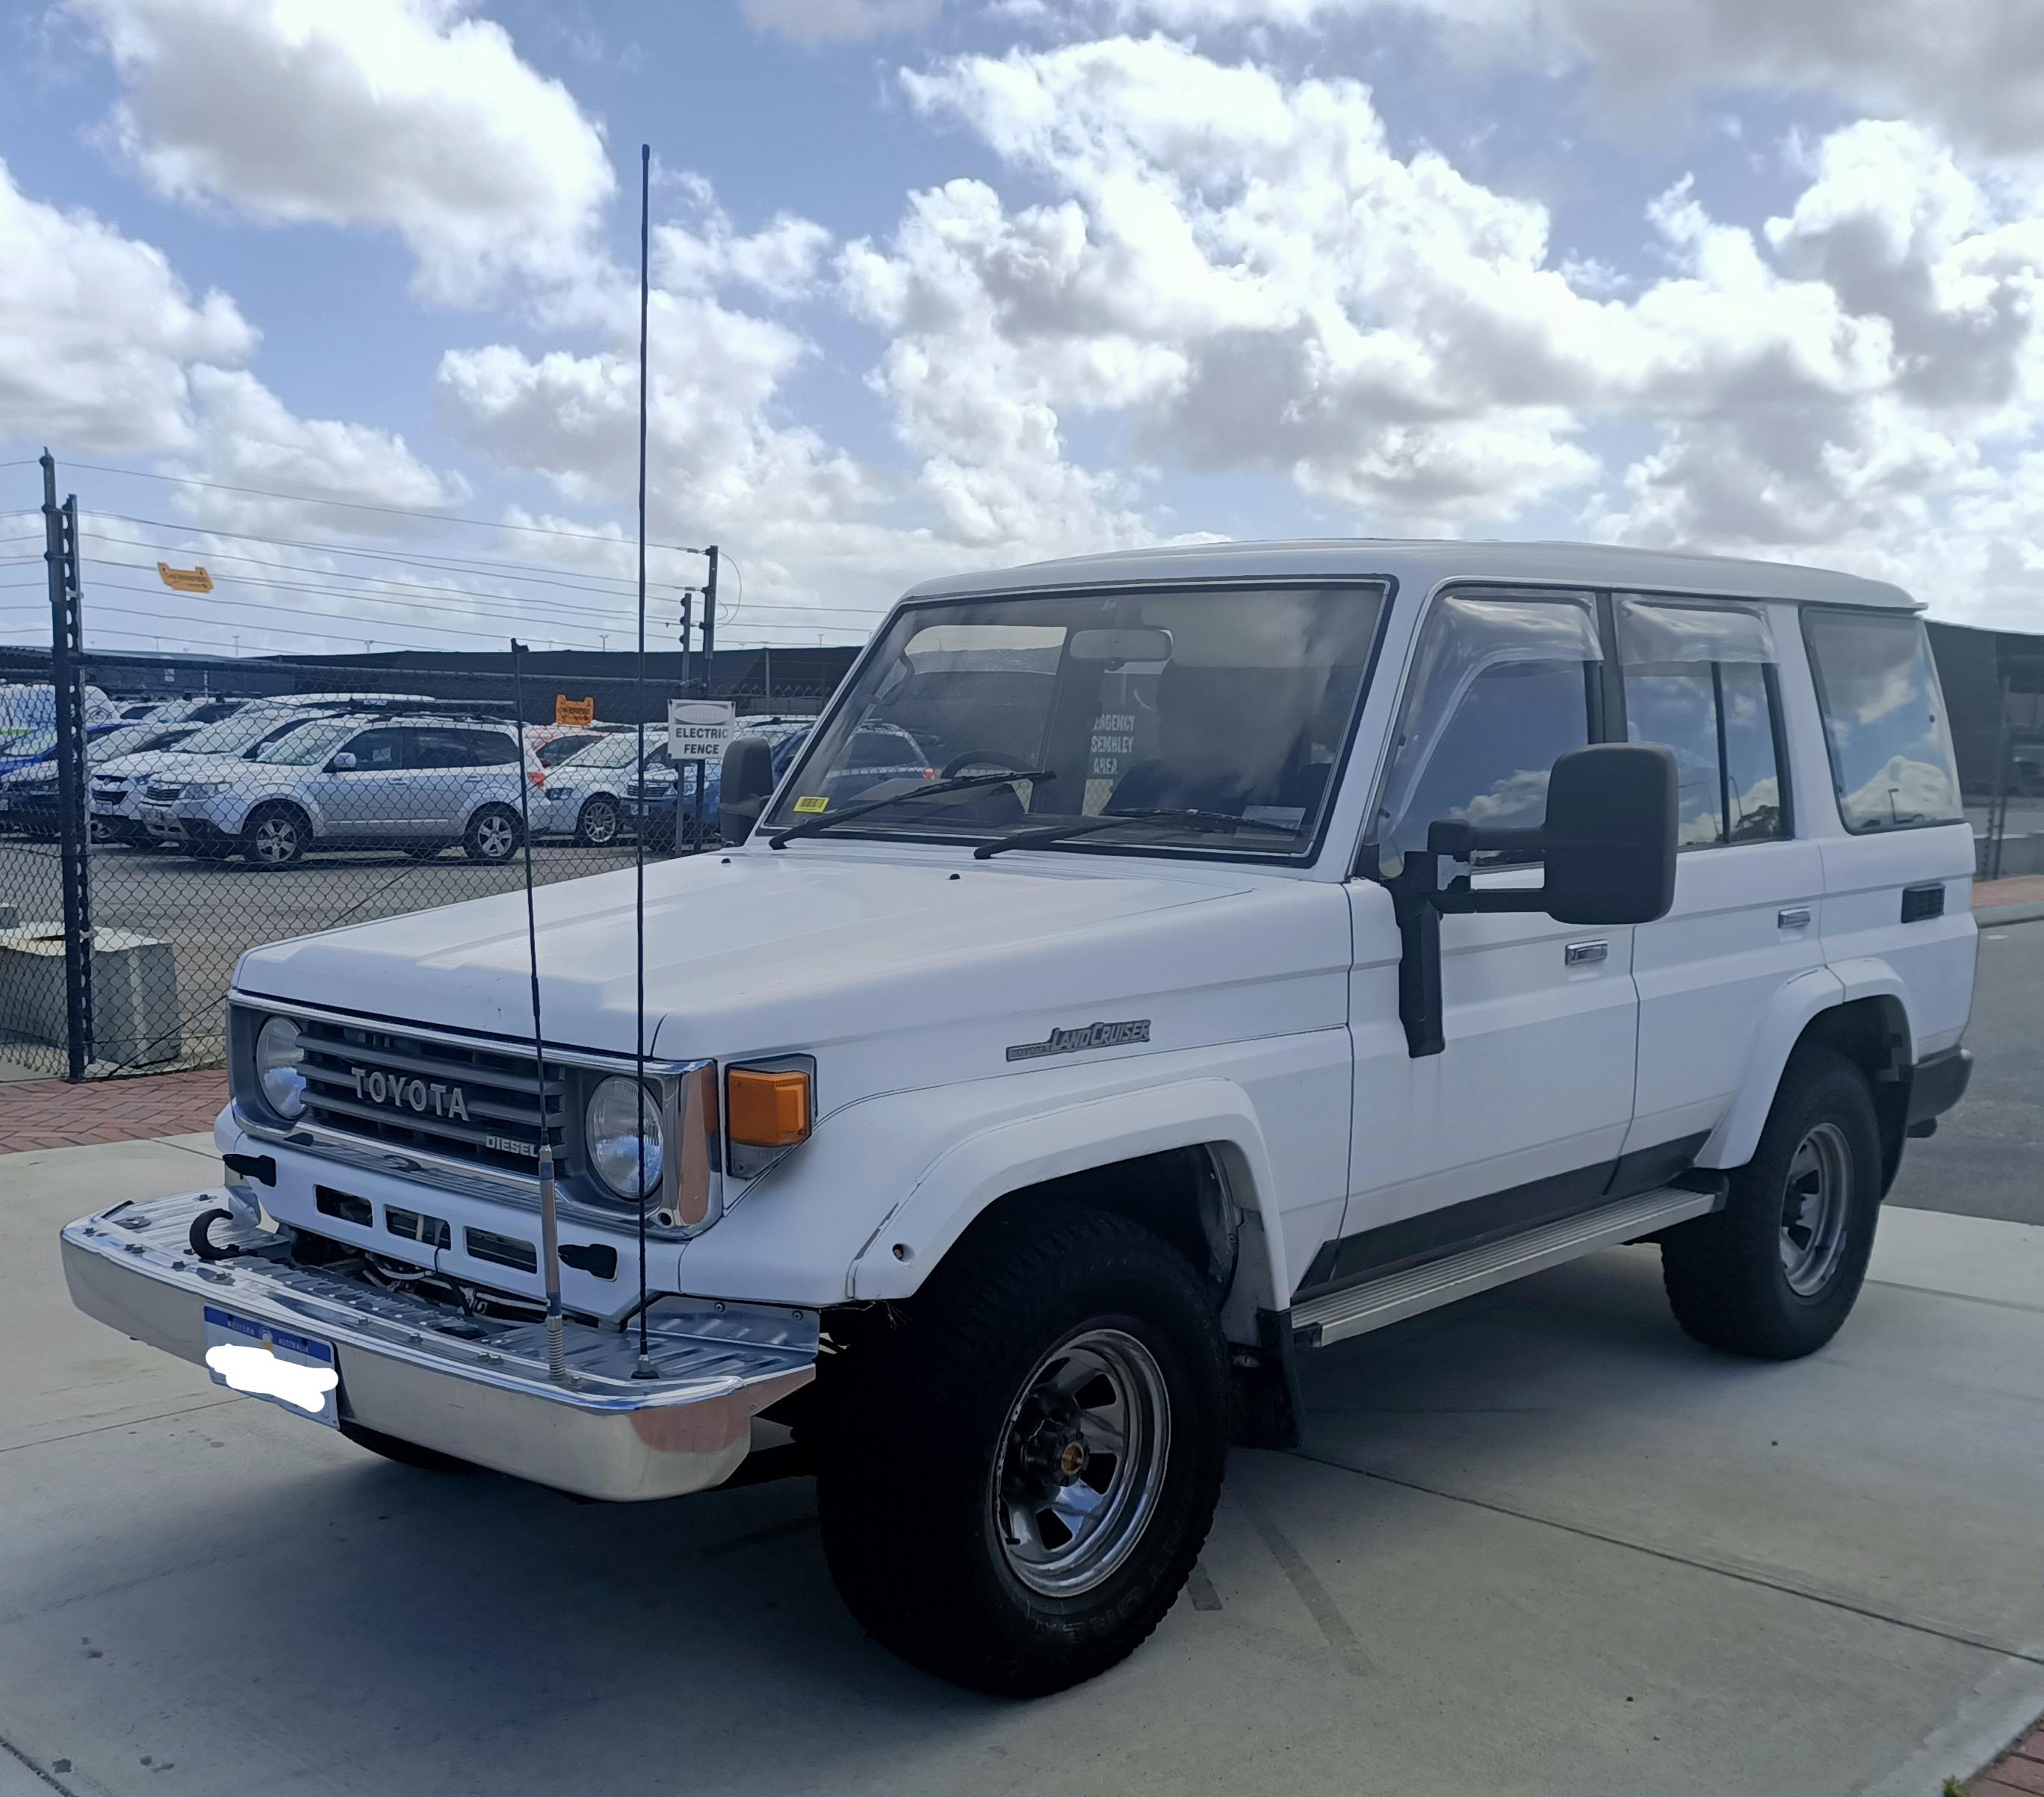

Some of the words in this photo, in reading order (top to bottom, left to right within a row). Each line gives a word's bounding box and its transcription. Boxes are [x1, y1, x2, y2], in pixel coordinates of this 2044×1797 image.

[675, 727, 728, 739] ELECTRIC
[684, 744, 719, 754] FENCE
[1092, 757, 1118, 775] AREA
[351, 1067, 470, 1122] TOYOTA
[486, 1135, 539, 1158] DIESEL
